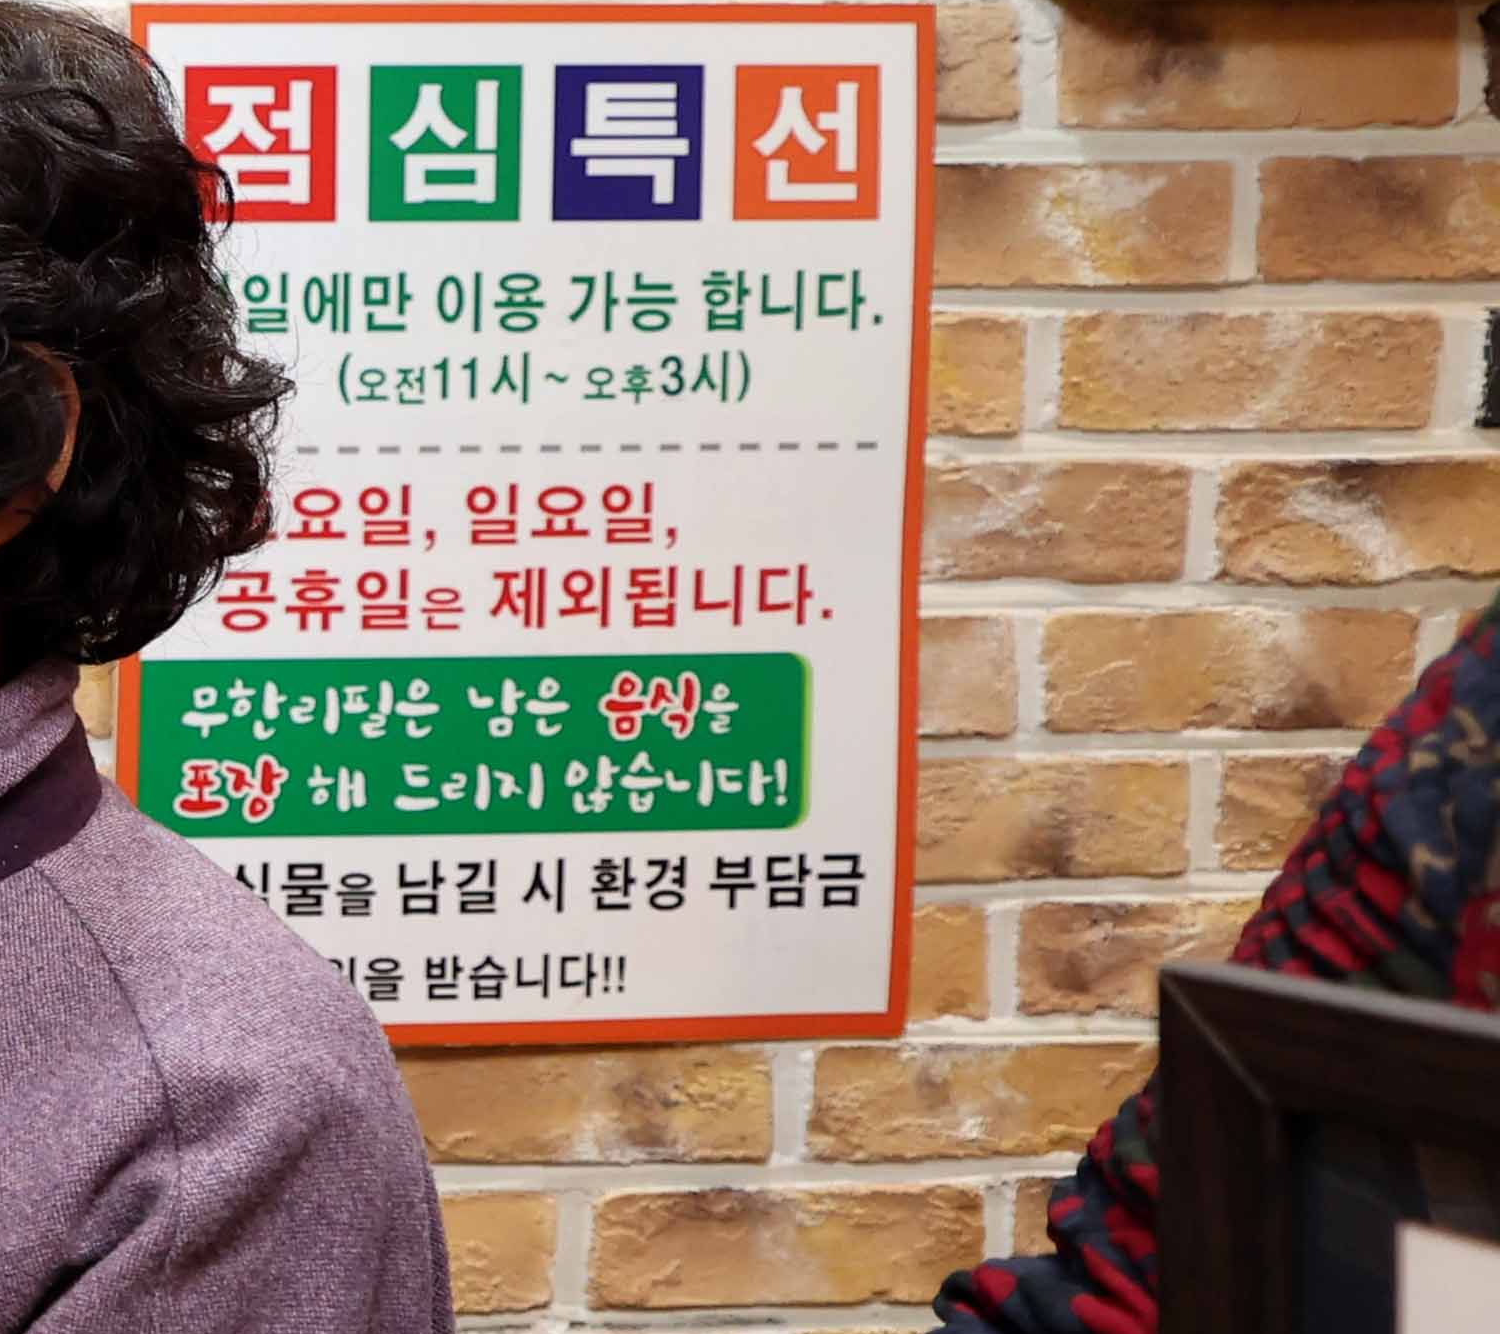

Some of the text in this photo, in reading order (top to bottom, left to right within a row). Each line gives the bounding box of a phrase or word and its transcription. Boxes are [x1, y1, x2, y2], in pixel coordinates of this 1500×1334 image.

[203, 79, 860, 205] 점심특선
[224, 268, 884, 335] 일에만 이용 가능 합니다.
[338, 353, 531, 405] (오전11시
[583, 350, 752, 404] 오후3시)
[264, 482, 679, 552] 요일, 일요일,
[216, 565, 833, 633] 공휴일은 제외됩니다.
[181, 670, 740, 743] 무한리필은 남은 음식을
[173, 751, 788, 824] 포장 해 드리지 않습니다!
[397, 859, 497, 916] 남길
[522, 857, 566, 913] 시
[589, 856, 688, 913] 환경
[707, 852, 867, 910] 부담금
[424, 953, 628, 1002] 받습니다!!
